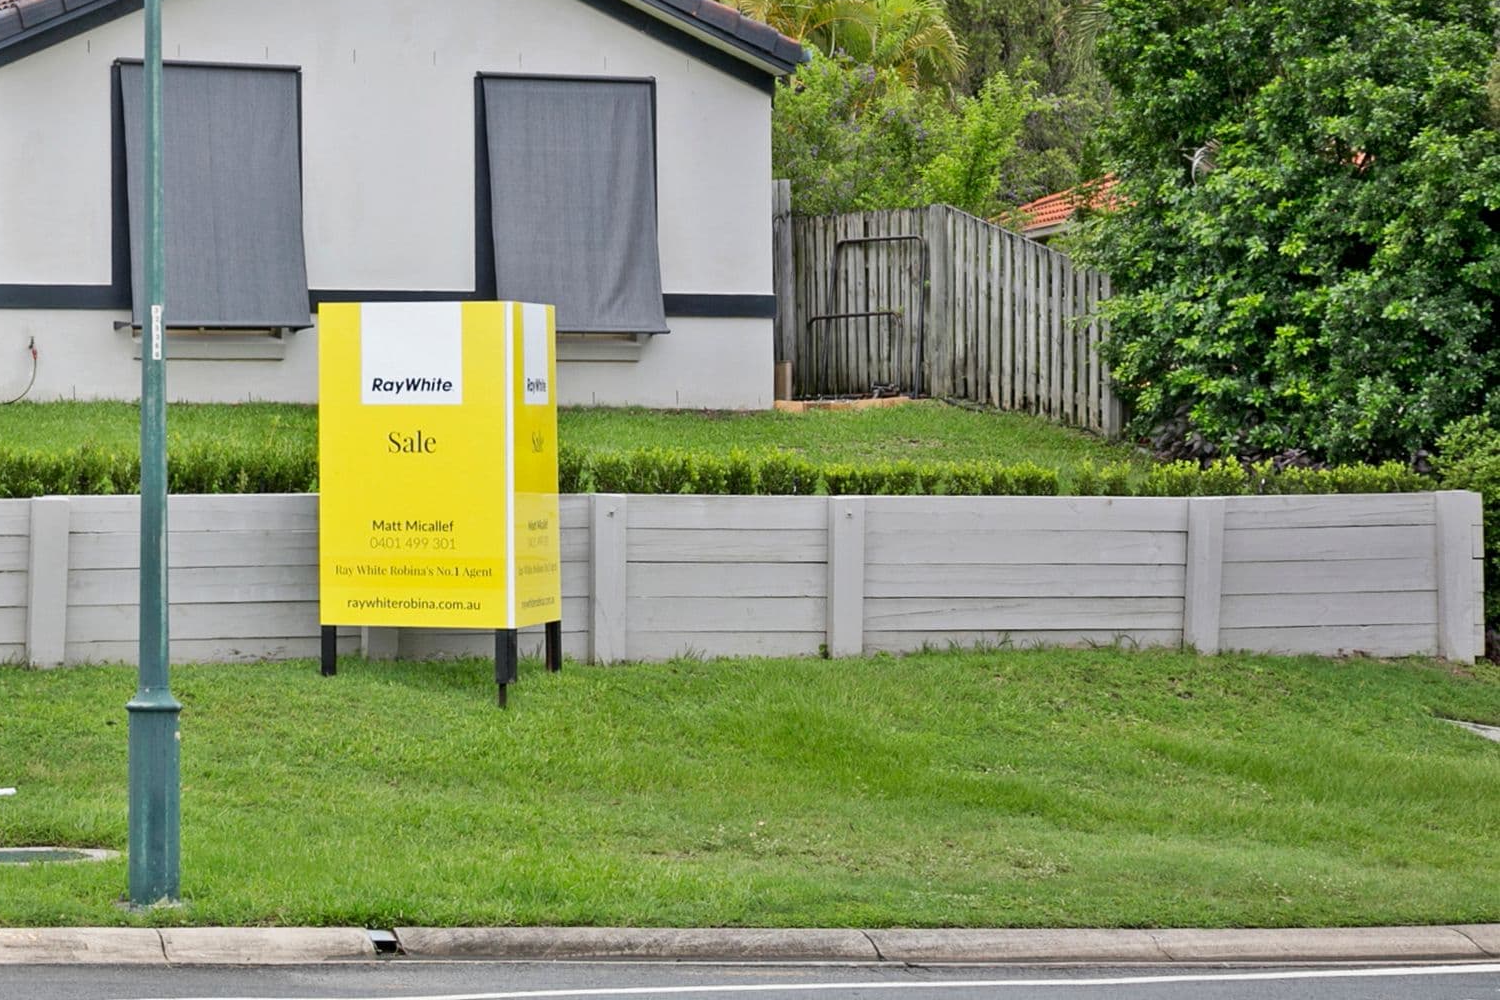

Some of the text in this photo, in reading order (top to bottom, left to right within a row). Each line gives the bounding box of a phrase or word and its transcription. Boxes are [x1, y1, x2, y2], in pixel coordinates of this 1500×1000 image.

[388, 430, 437, 453] Sale
[372, 520, 454, 532] Matt Micallef
[369, 537, 456, 550] 0401 499 301
[336, 565, 353, 576] Ray
[357, 565, 387, 576] White
[390, 566, 434, 577] Robina's
[462, 567, 492, 579] Agent
[347, 597, 481, 611] raywhiterobina.com.au
